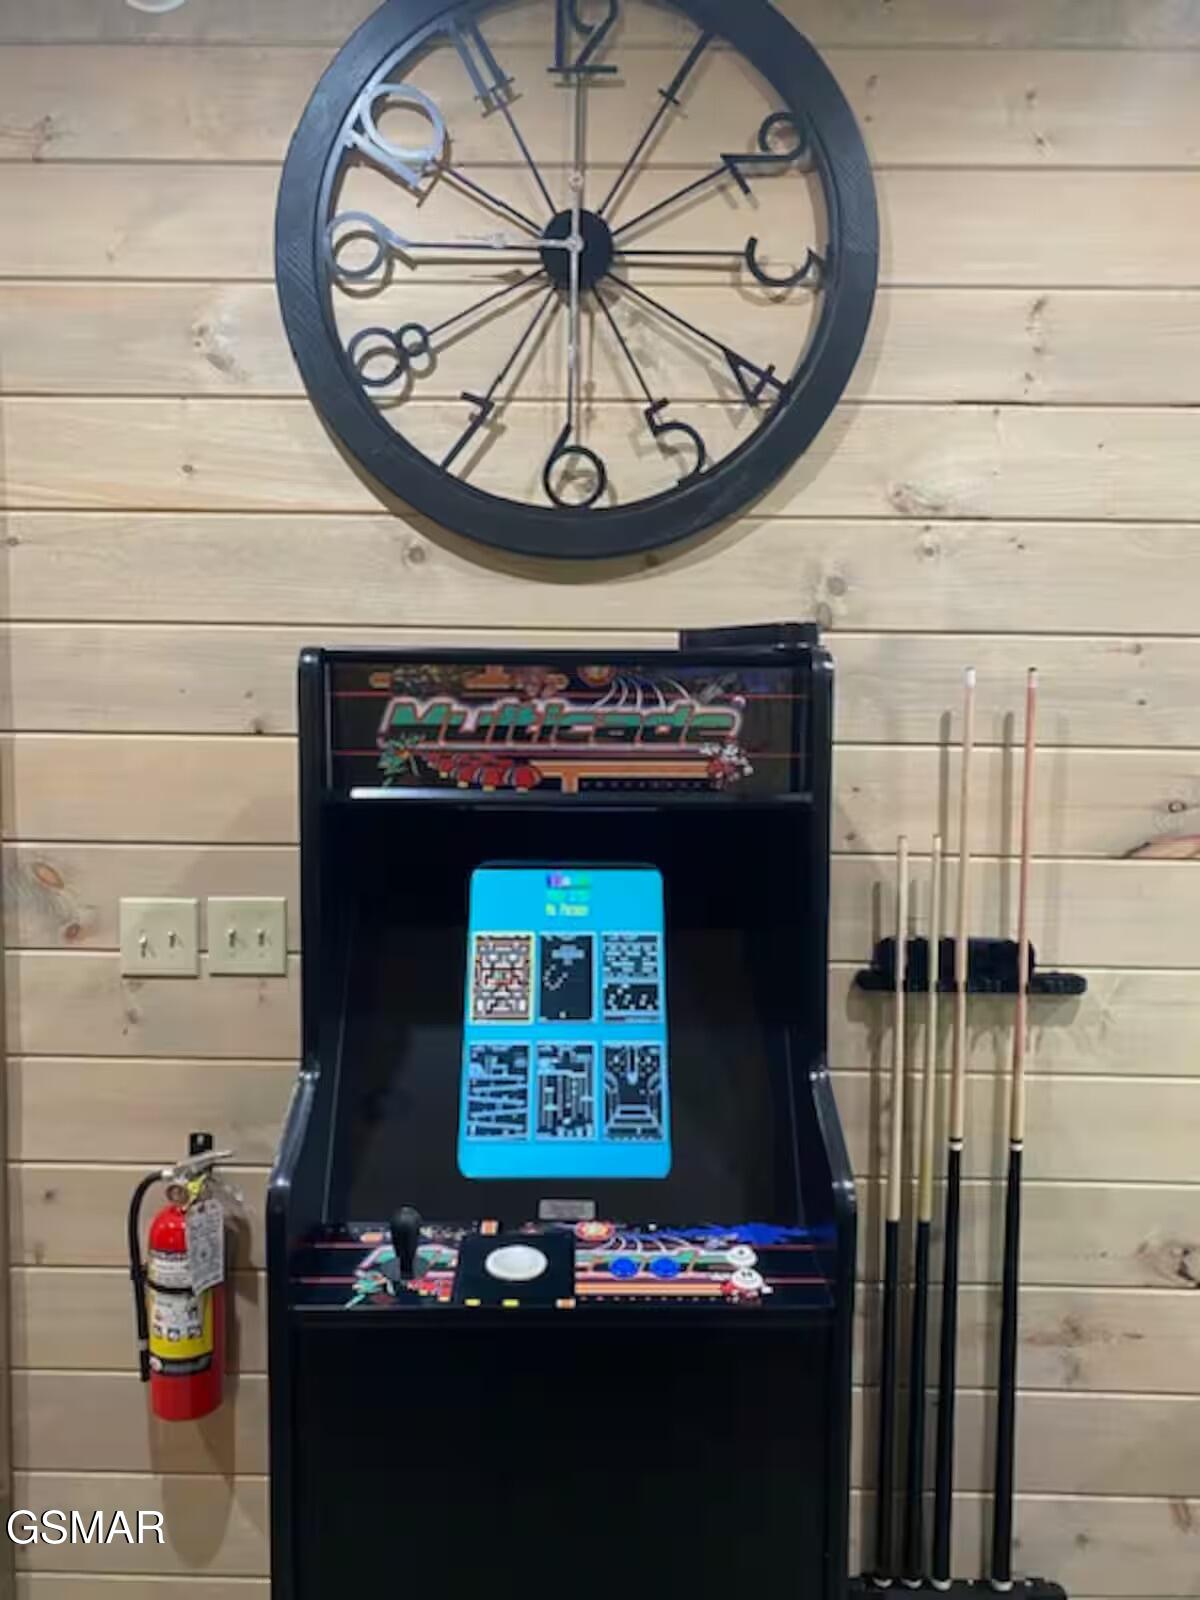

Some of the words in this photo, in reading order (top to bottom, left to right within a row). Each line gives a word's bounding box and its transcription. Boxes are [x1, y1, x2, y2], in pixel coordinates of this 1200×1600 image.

[547, 0, 617, 74] 12
[657, 30, 711, 105] 1
[348, 82, 447, 192] 10
[720, 111, 809, 194] 2
[328, 210, 410, 279] 9
[745, 236, 828, 288] 3
[348, 322, 430, 388] 8
[724, 349, 794, 407] 4
[440, 390, 495, 471] 7
[542, 423, 607, 509] 6
[644, 397, 706, 486] 5
[377, 696, 743, 750] Multicade
